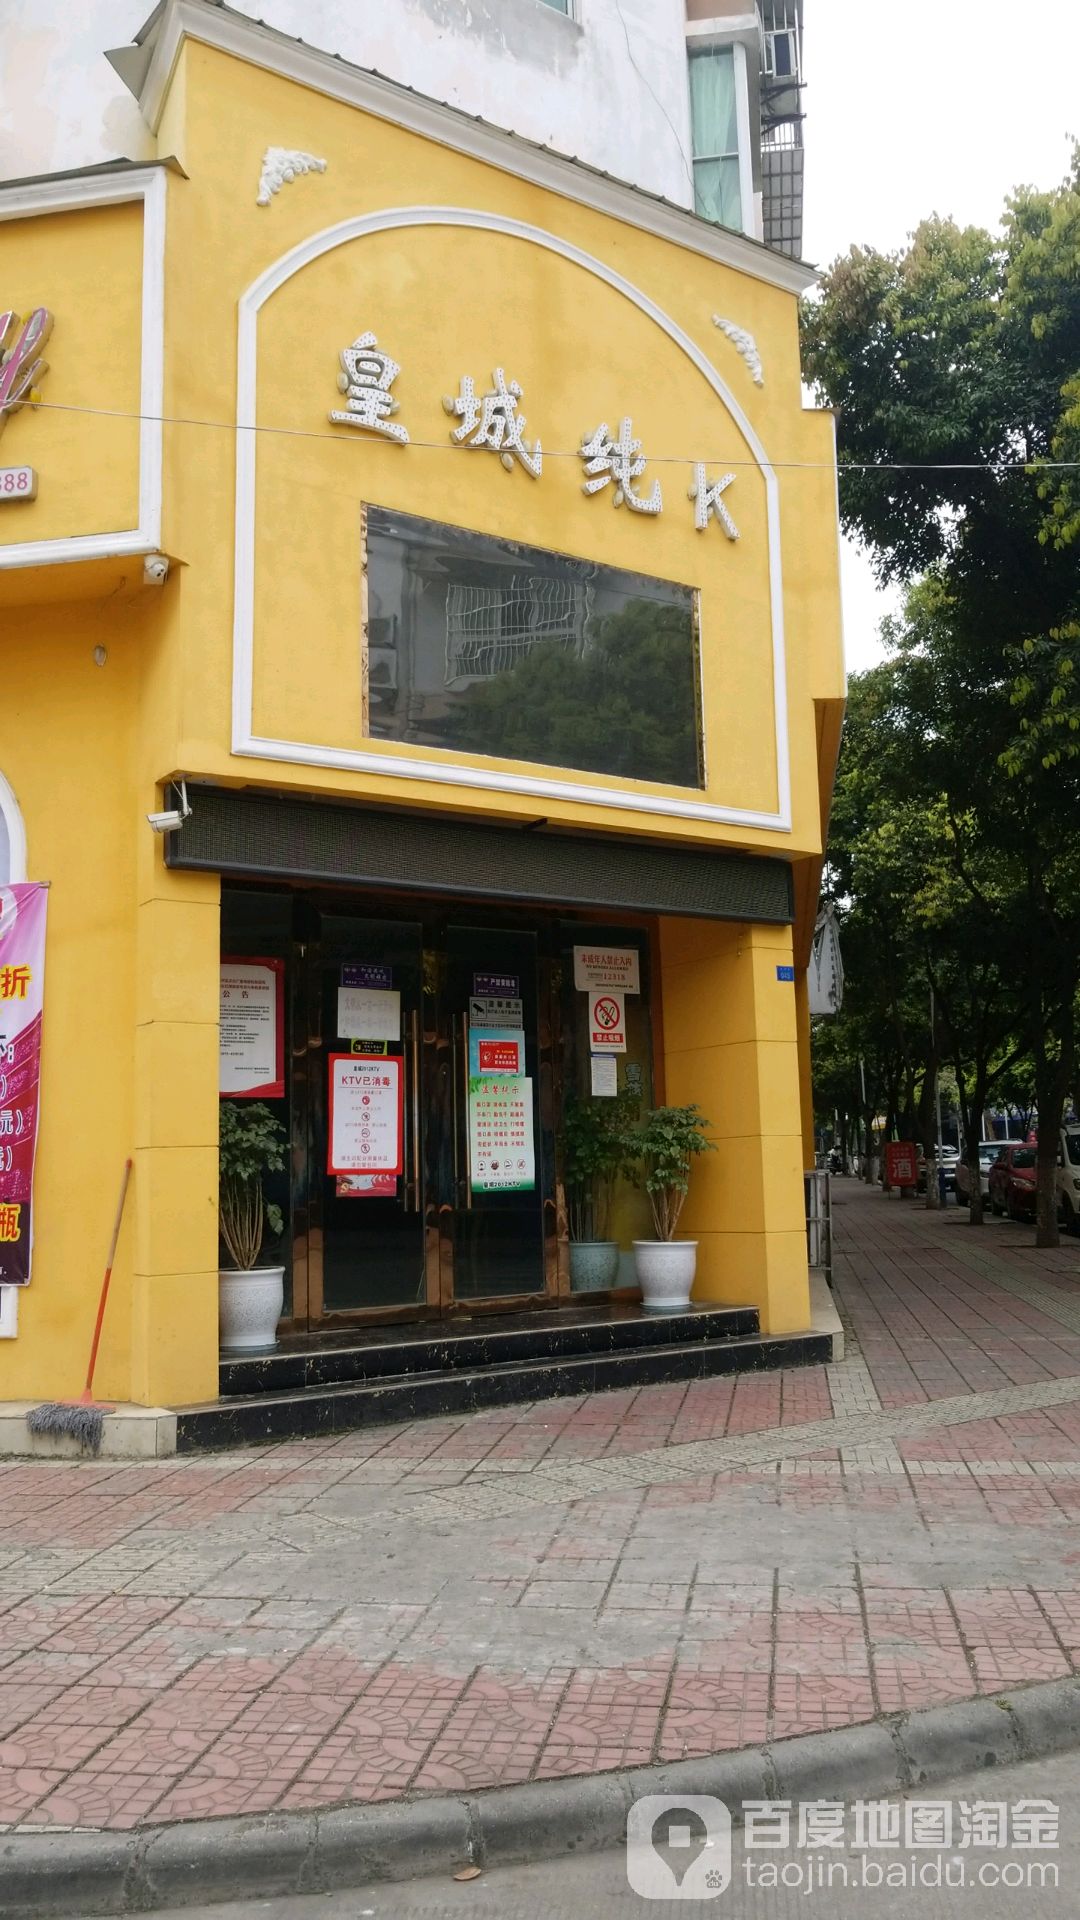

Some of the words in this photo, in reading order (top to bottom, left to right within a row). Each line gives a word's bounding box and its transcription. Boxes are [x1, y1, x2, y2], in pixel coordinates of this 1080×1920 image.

[328, 331, 740, 541] 皇城纯K
[0, 472, 28, 492] 88
[581, 953, 632, 967] 未成年人禁止入内
[1, 966, 29, 997] 折
[596, 1034, 621, 1043] 禁止吸烟
[341, 1076, 391, 1087] KTV已消毒
[892, 1158, 912, 1179] 酒
